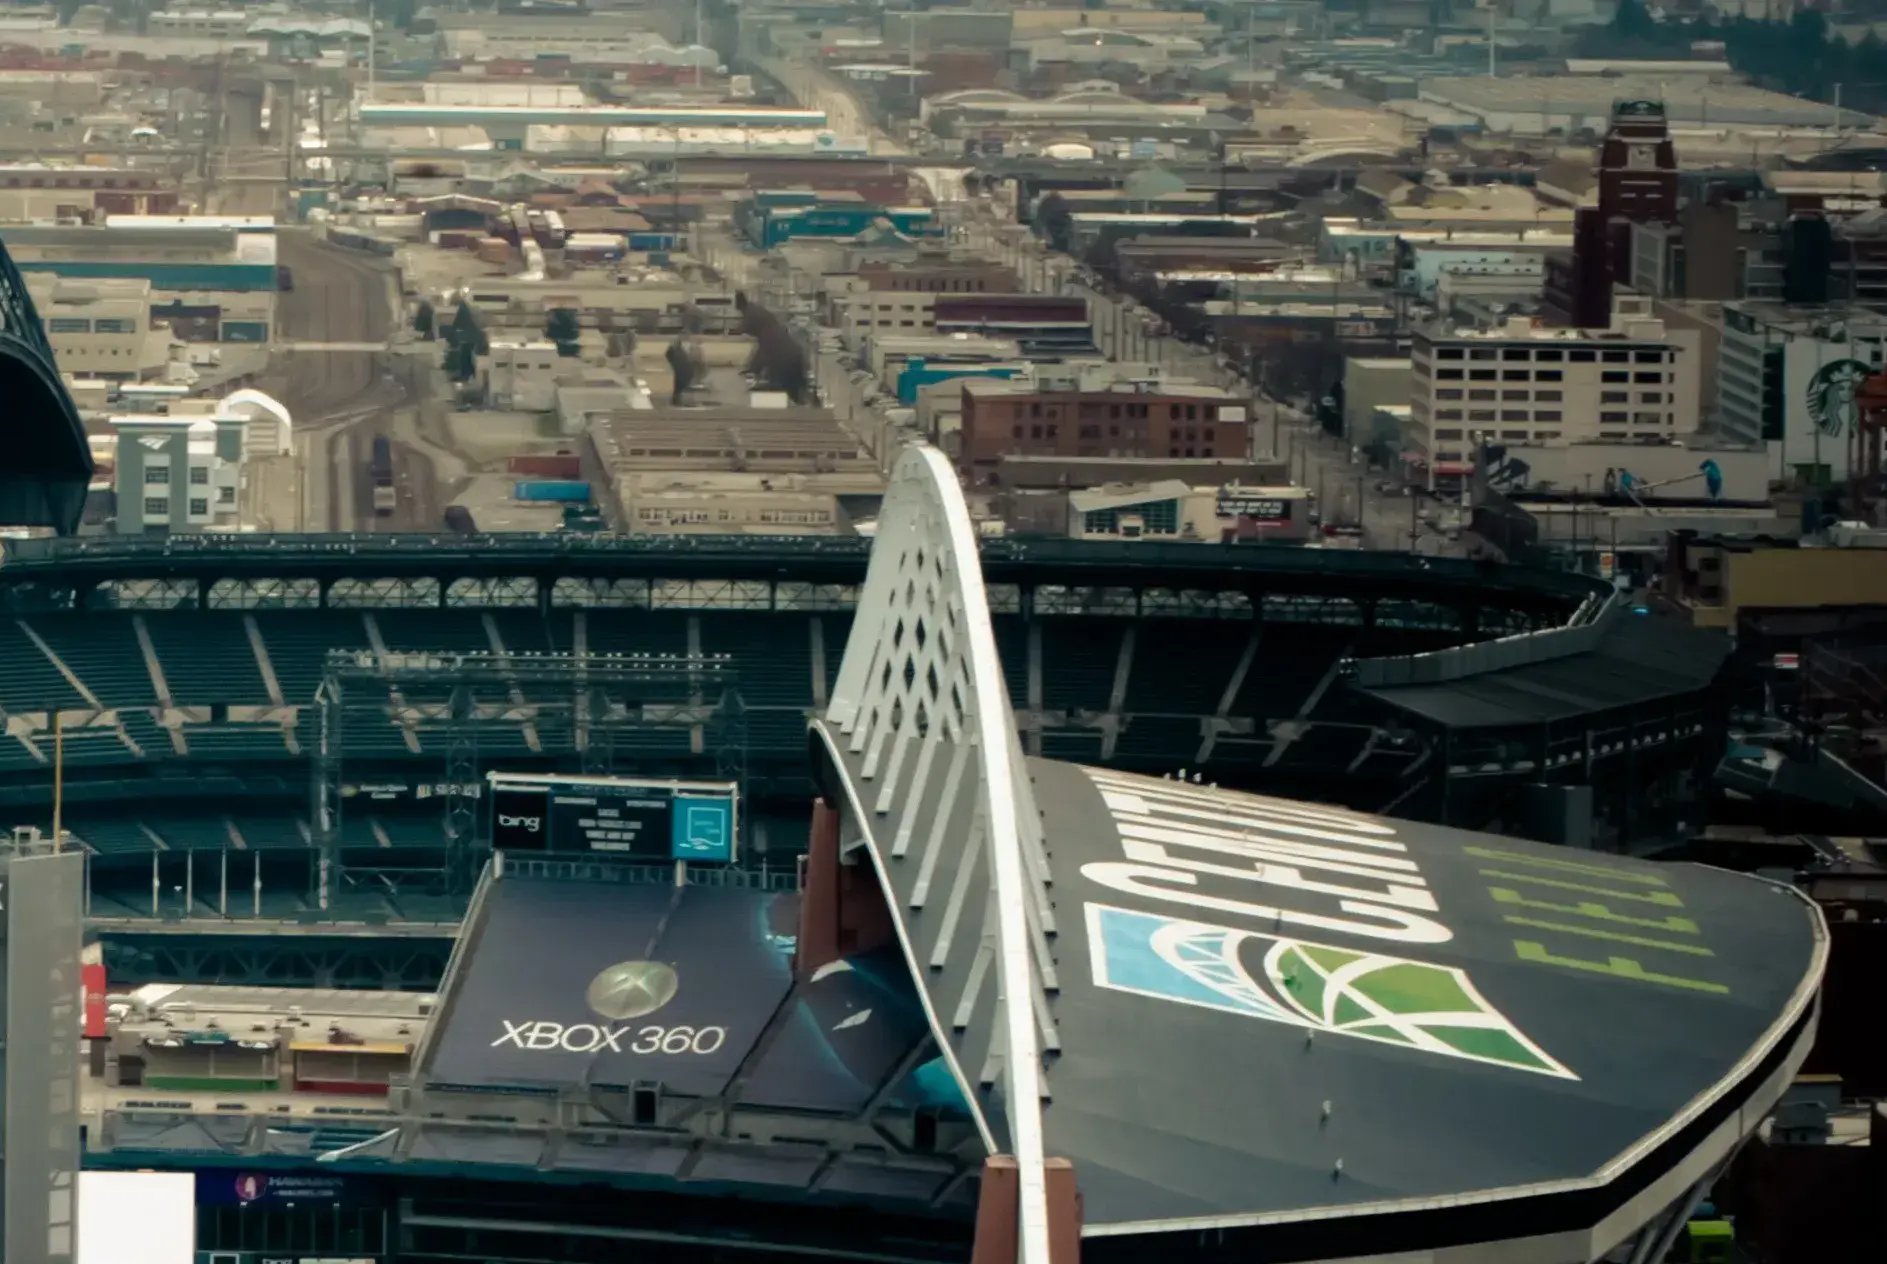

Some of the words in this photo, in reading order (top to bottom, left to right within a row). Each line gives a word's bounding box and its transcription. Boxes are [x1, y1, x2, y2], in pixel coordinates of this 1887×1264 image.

[498, 814, 541, 832] bing
[490, 1019, 631, 1053] XBOX
[631, 1025, 726, 1055] 360
